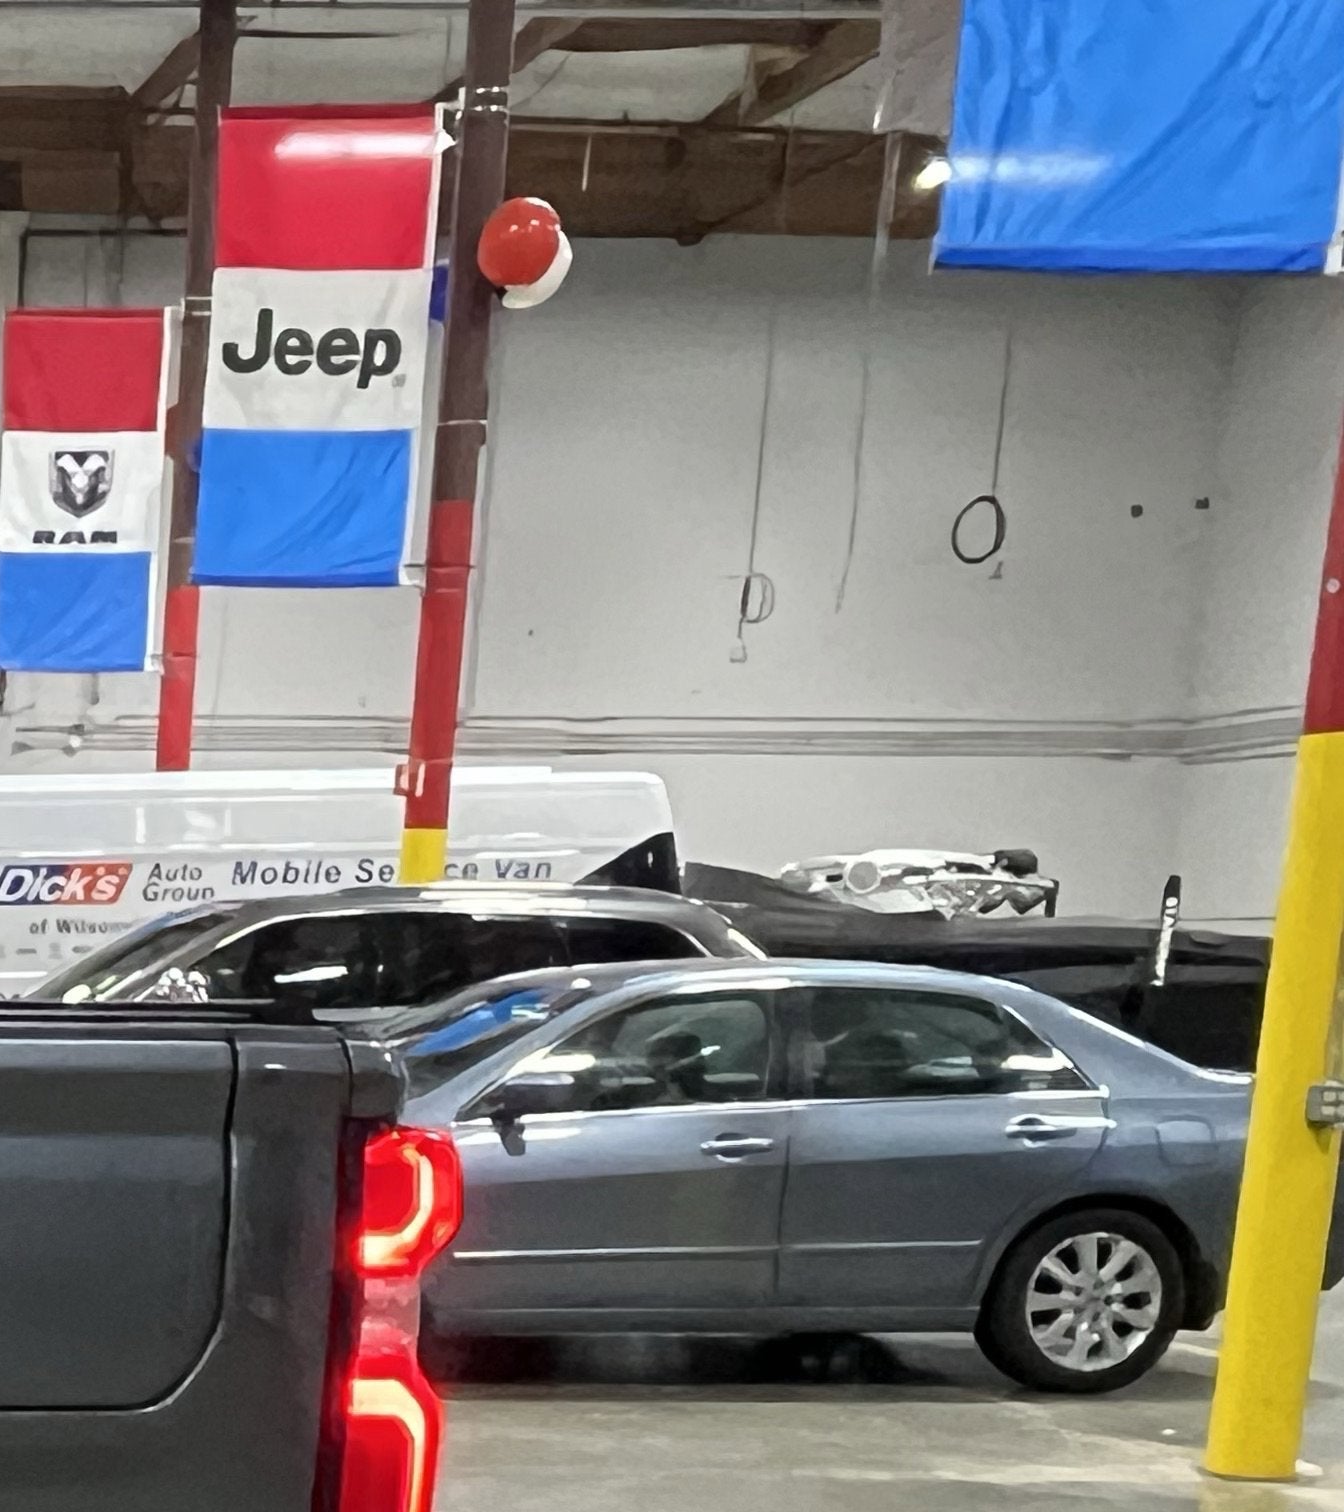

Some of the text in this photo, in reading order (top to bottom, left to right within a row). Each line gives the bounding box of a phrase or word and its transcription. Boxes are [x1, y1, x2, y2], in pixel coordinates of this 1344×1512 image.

[222, 308, 401, 388] Jeep
[148, 863, 202, 882] Auto
[232, 858, 553, 885] Mobile Sece Van
